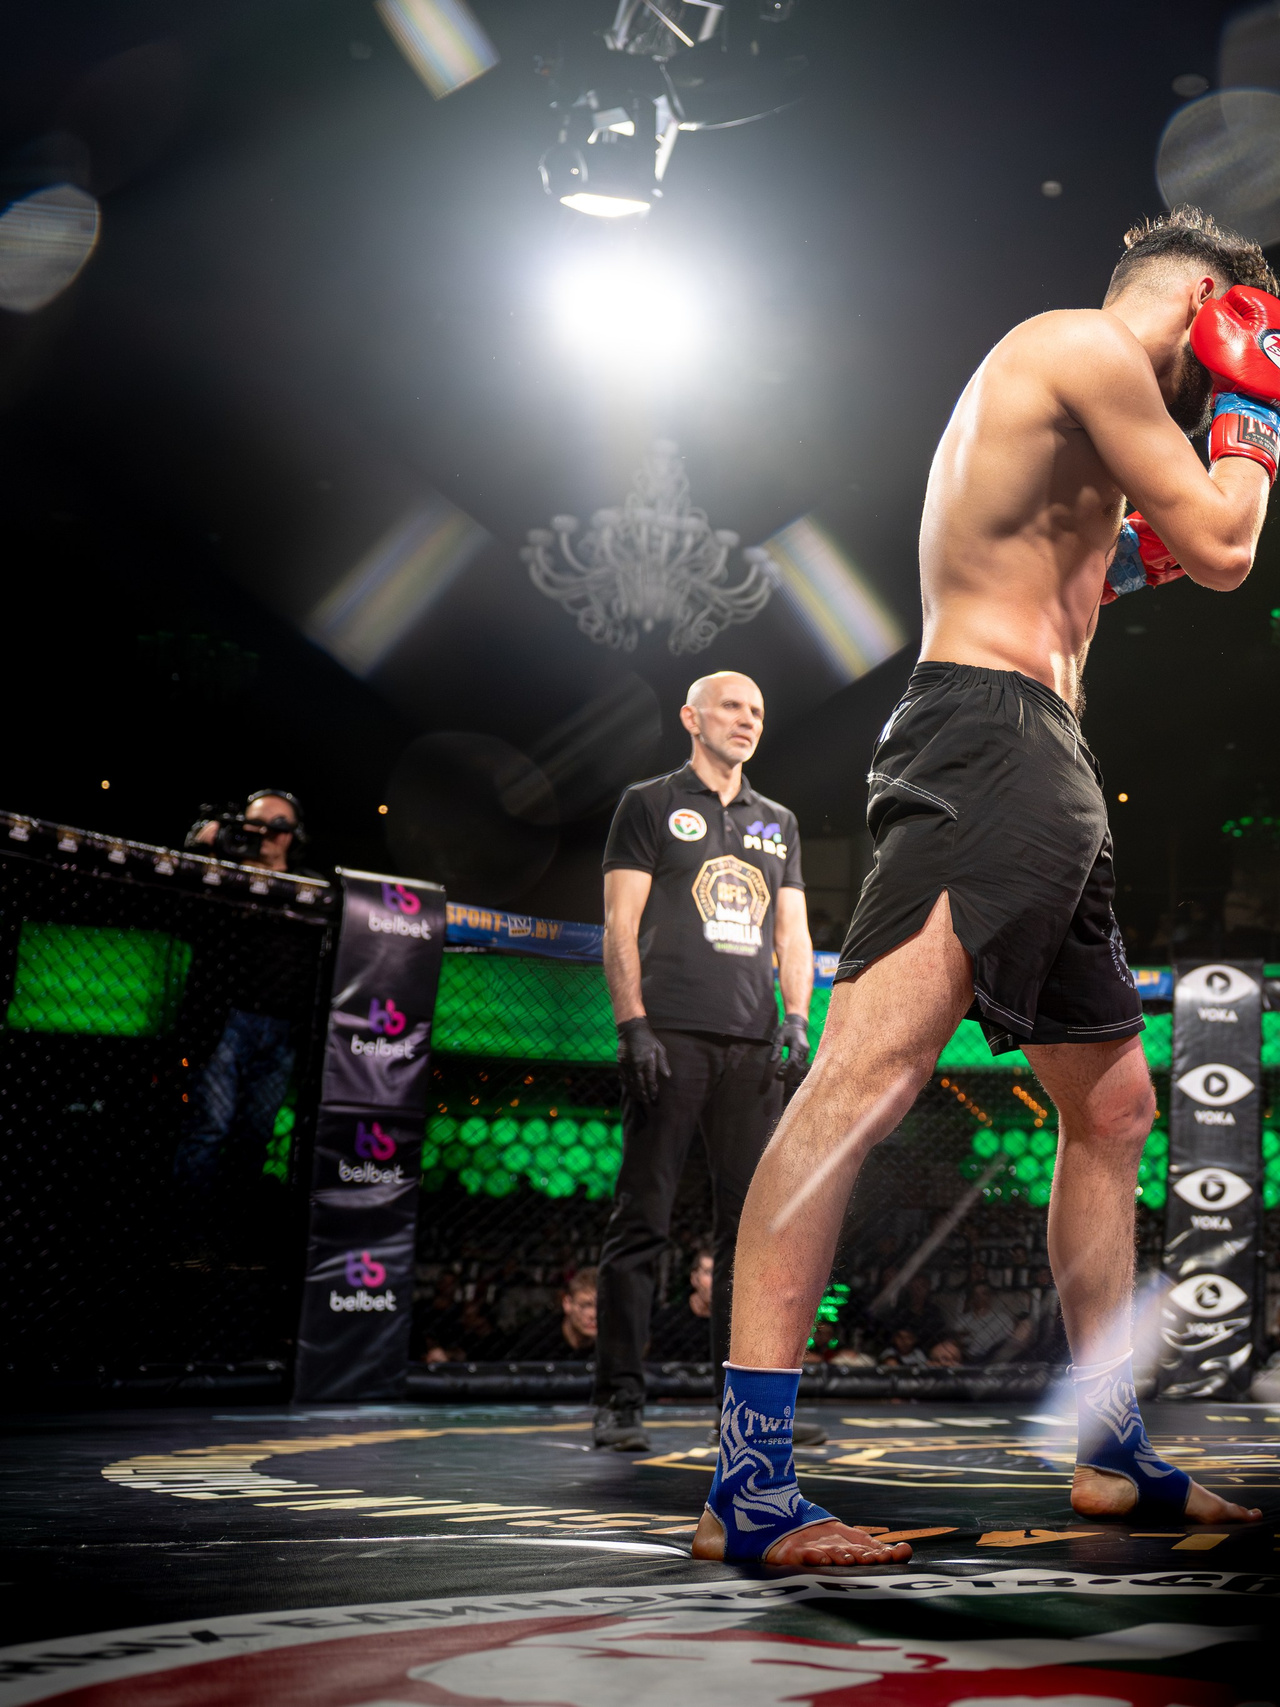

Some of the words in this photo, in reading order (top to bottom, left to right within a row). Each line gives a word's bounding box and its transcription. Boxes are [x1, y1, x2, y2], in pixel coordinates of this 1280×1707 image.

[1244, 415, 1278, 443] TWI
[368, 911, 431, 941] belbet
[706, 920, 763, 947] GORILLA
[1197, 1007, 1239, 1024] VOKA
[350, 1033, 415, 1061] belbet
[1194, 1110, 1236, 1126] VOKA
[338, 1158, 404, 1185] belbet
[1191, 1215, 1233, 1231] VOKA
[329, 1289, 397, 1313] belbet
